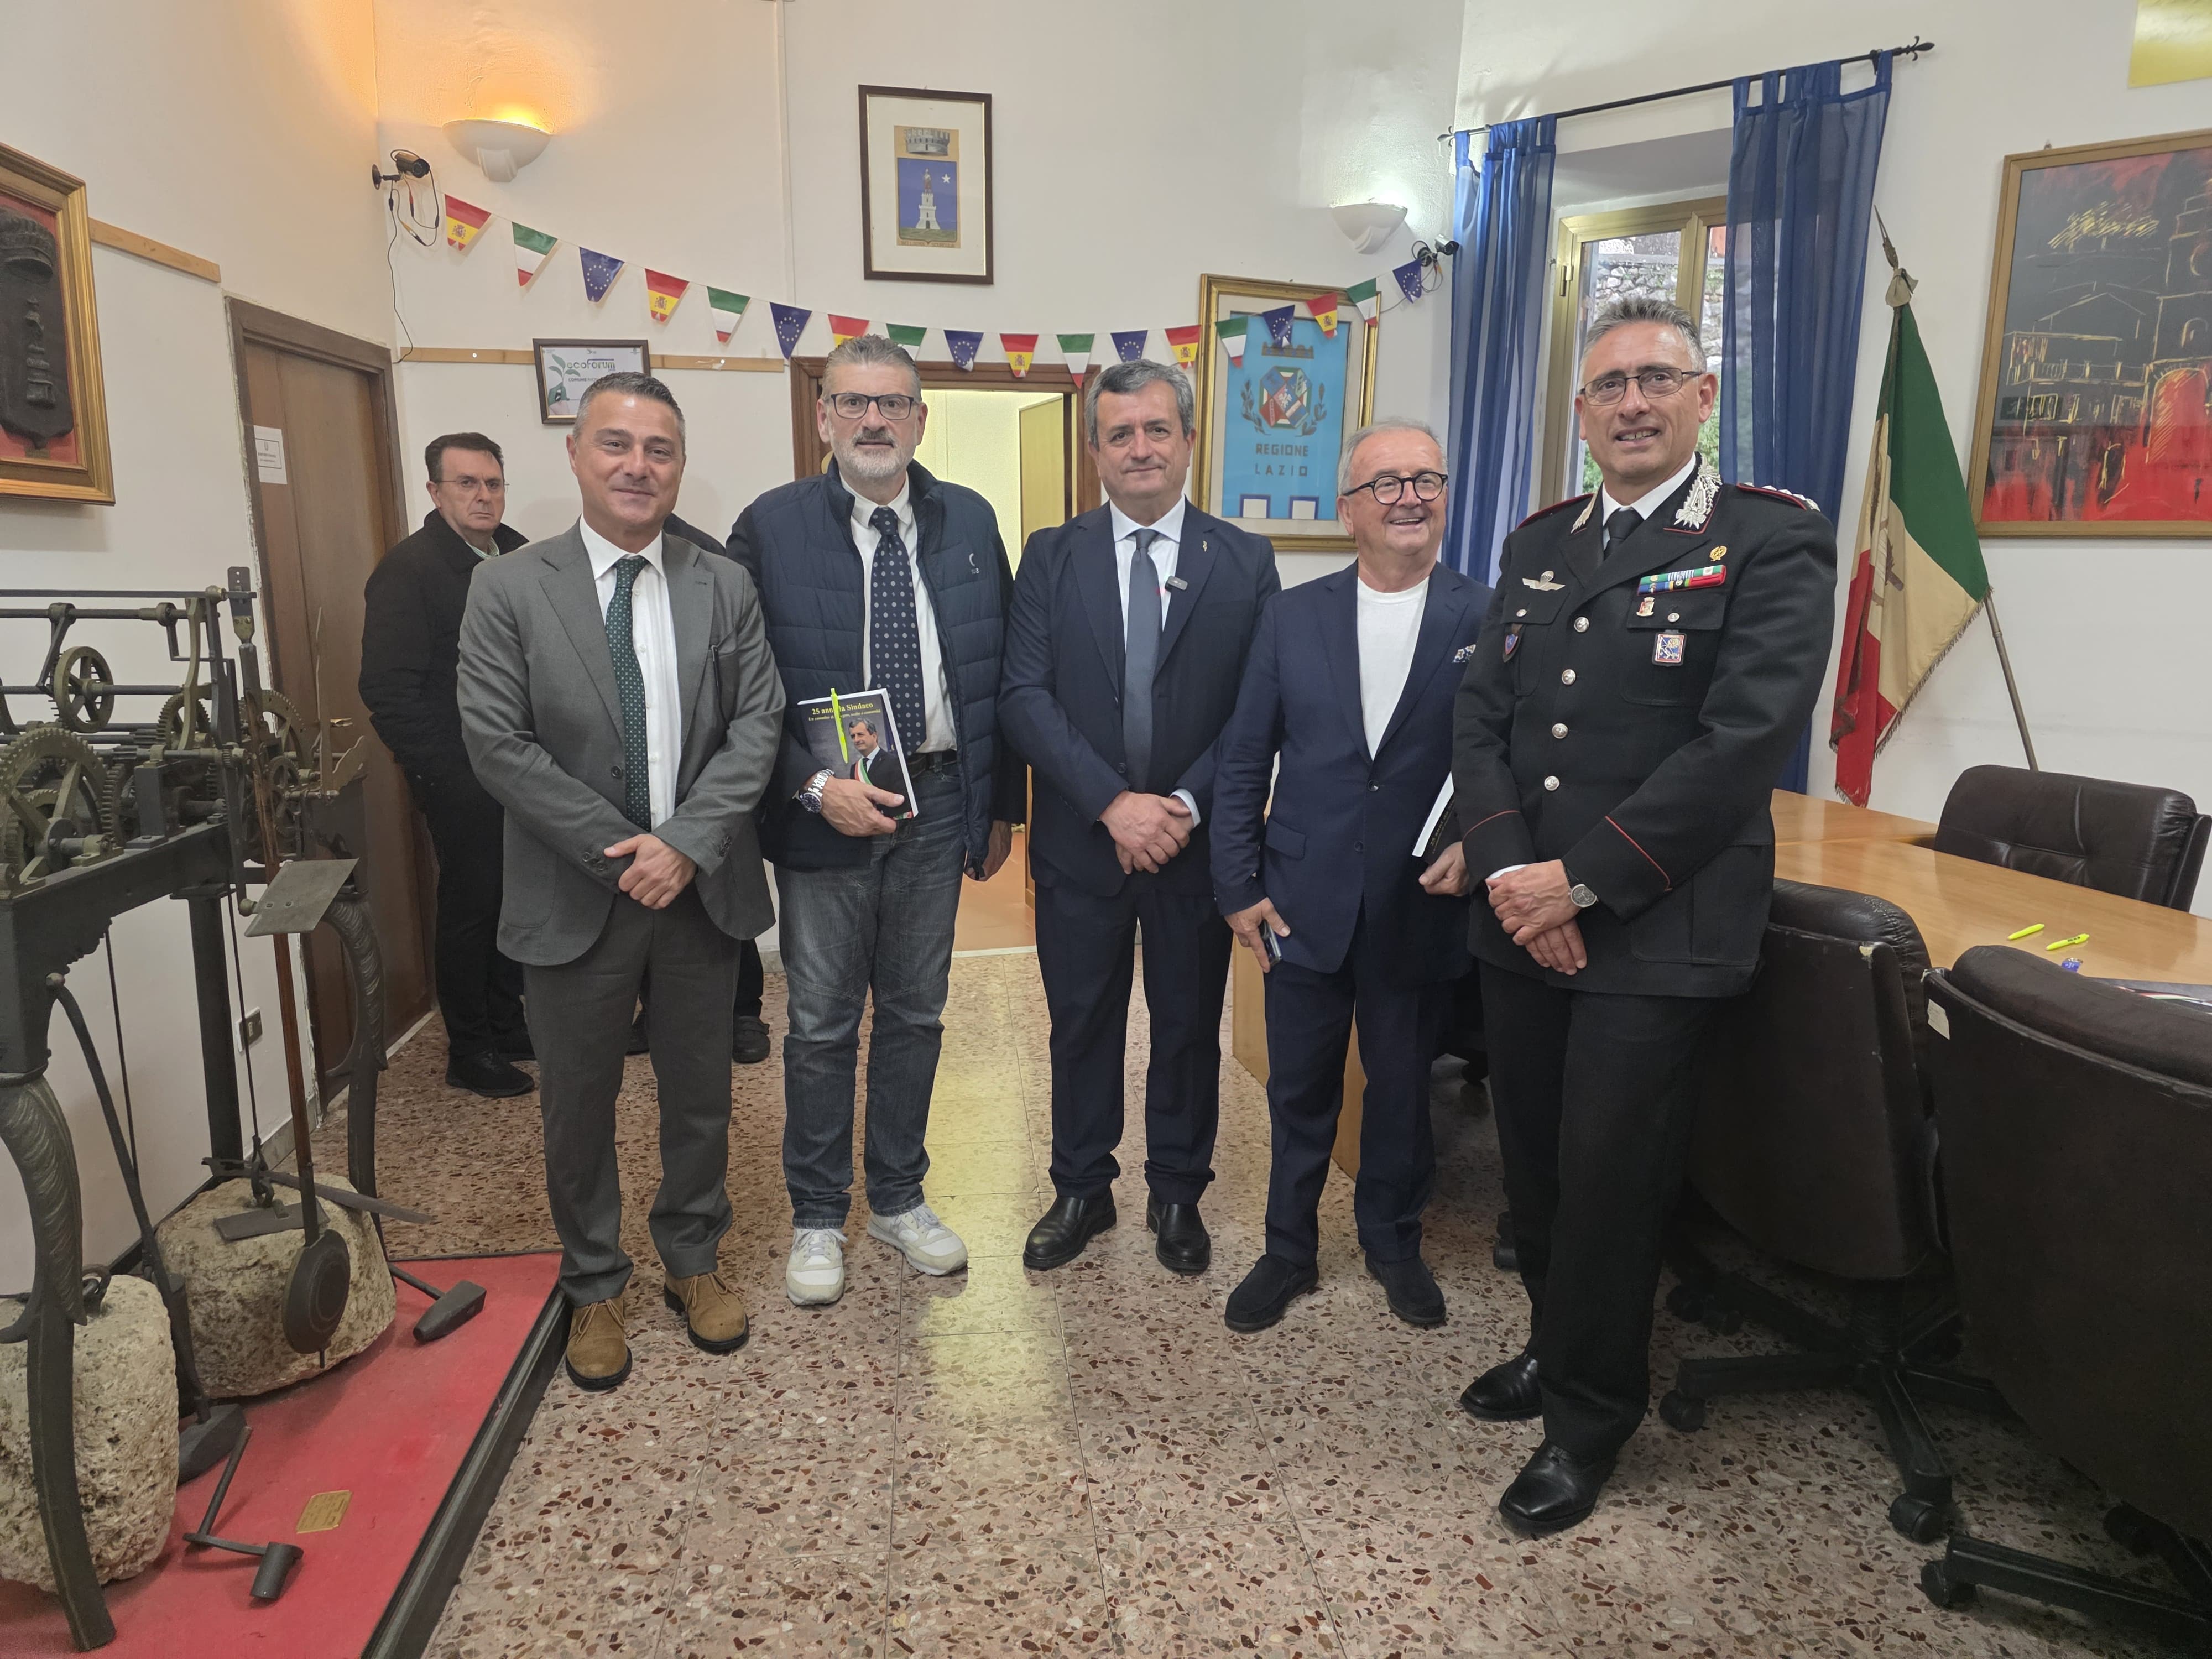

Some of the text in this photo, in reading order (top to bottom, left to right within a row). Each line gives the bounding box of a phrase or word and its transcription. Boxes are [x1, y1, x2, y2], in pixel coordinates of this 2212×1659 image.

[567, 358, 615, 369] ecoforum
[1256, 443, 1308, 457] REGIONE
[1255, 463, 1308, 477] LAZIO
